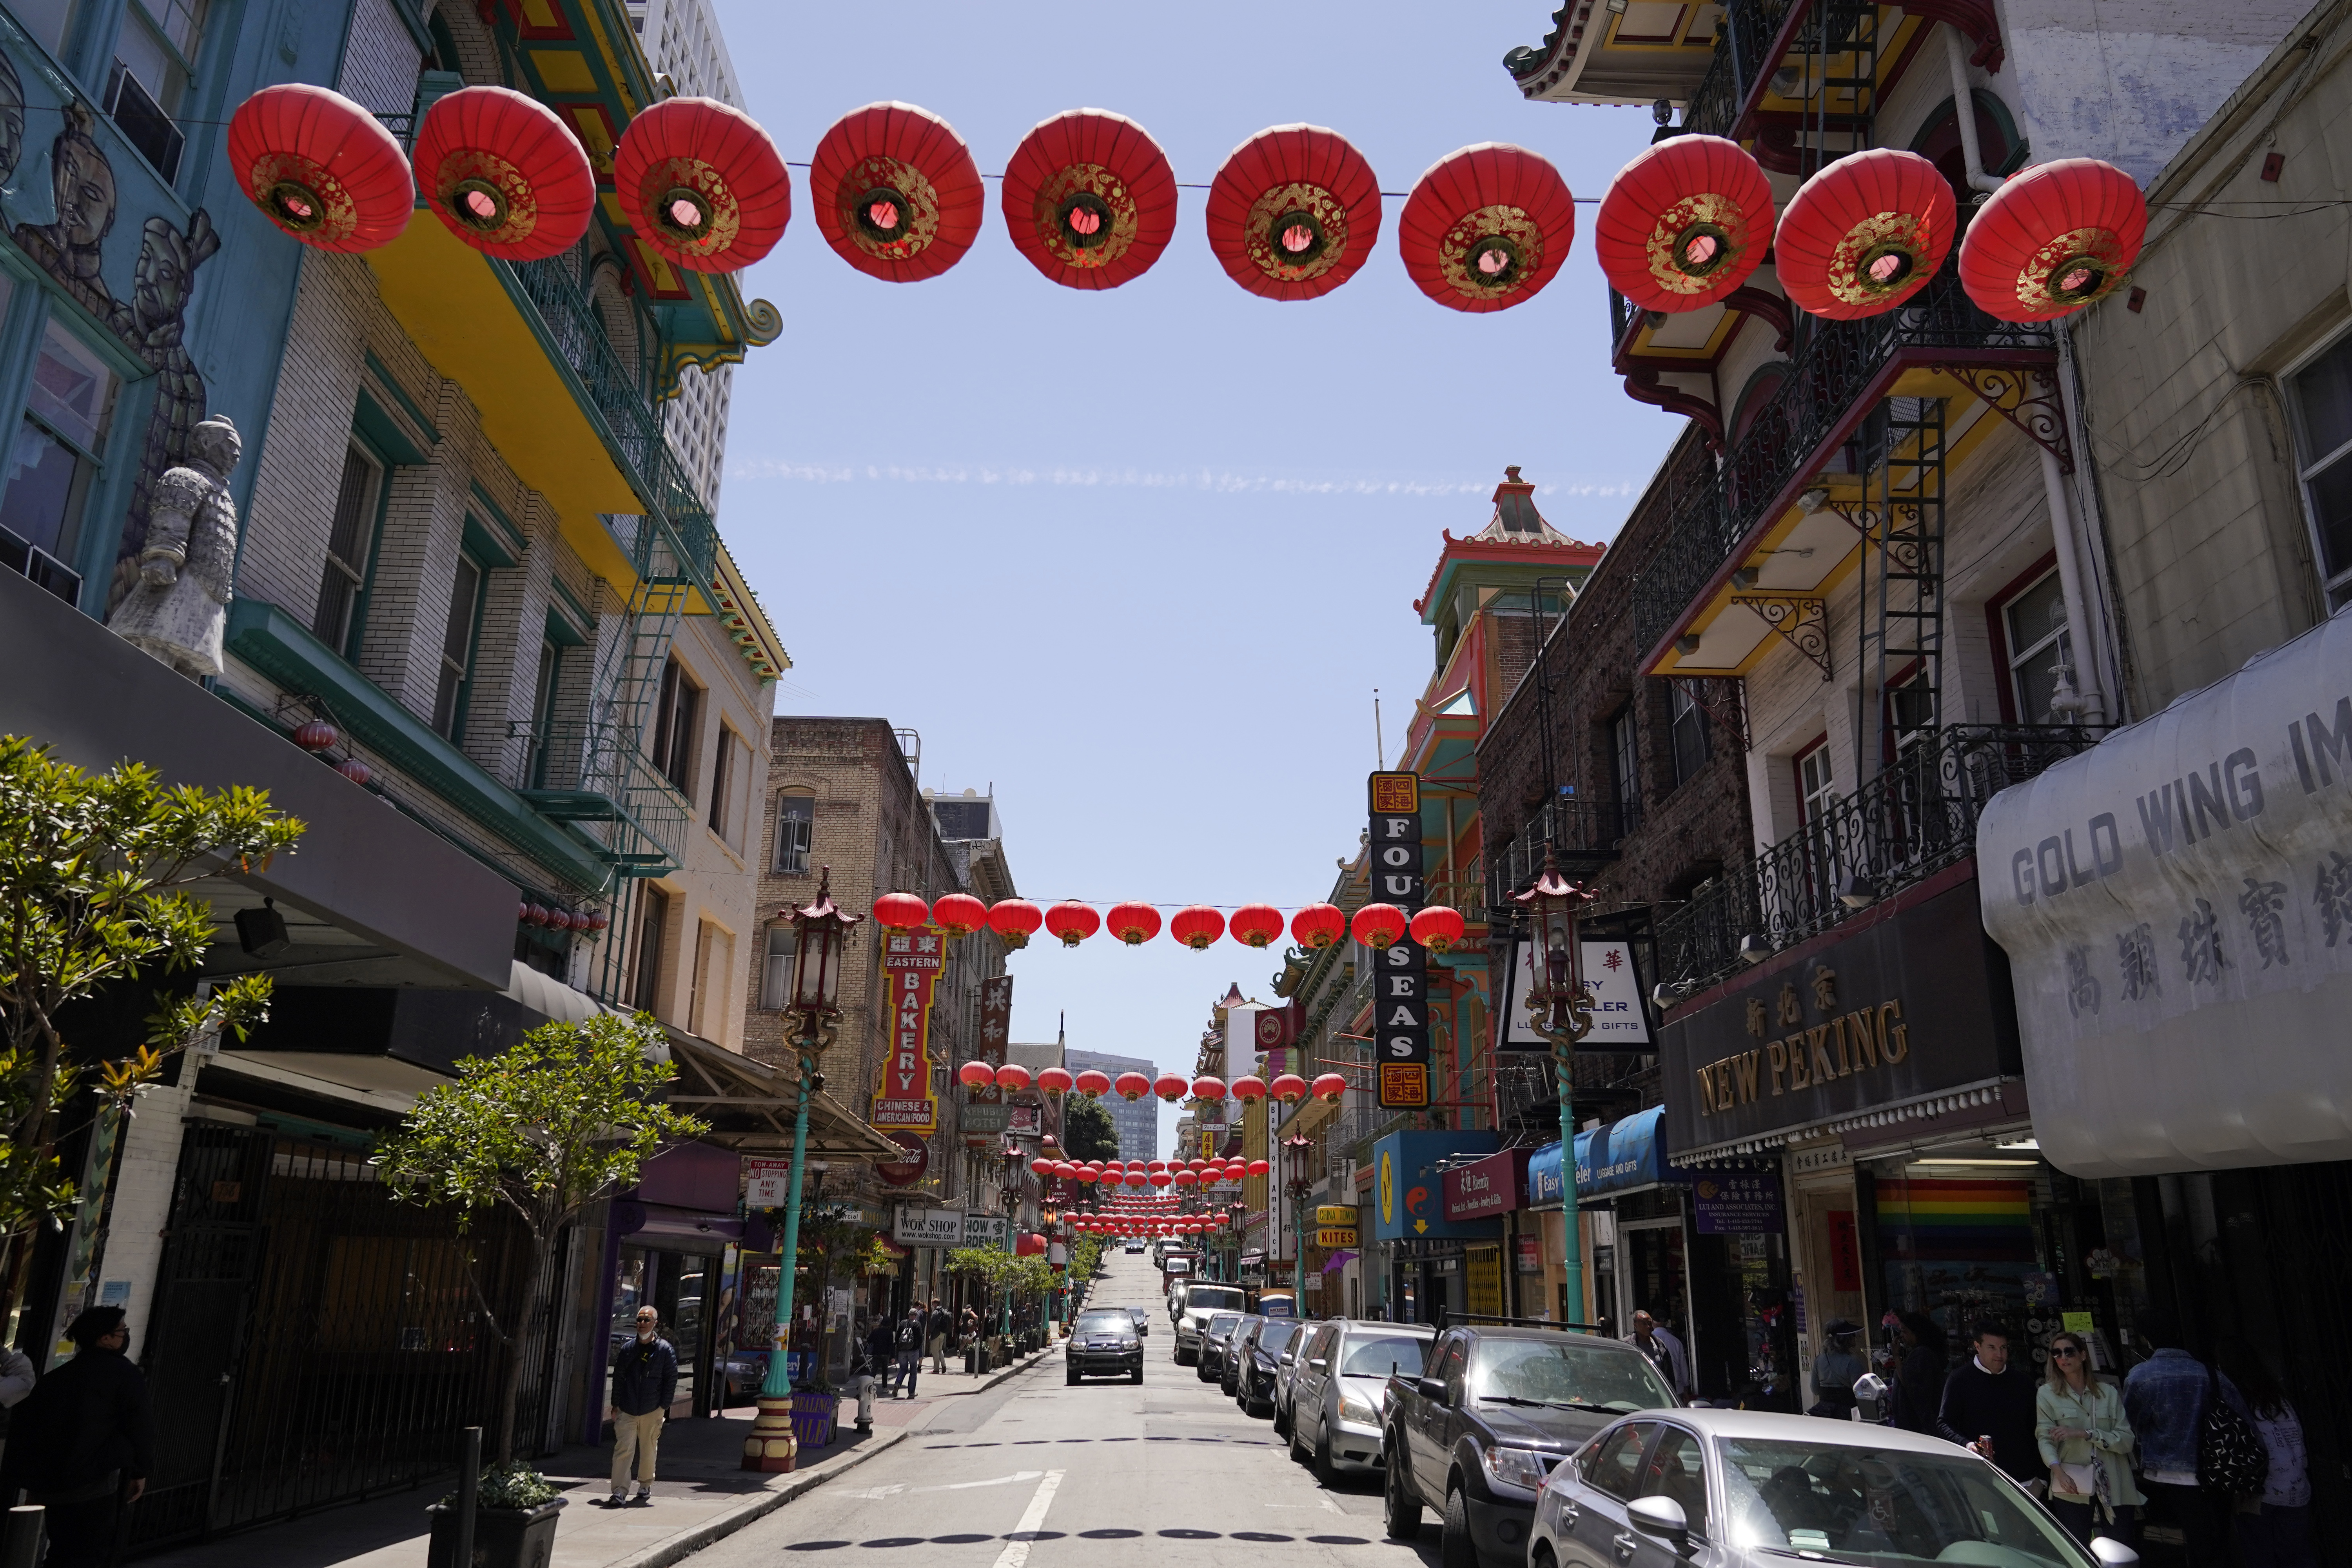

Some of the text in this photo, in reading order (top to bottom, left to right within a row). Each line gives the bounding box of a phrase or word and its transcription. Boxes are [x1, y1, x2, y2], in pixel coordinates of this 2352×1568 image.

[2012, 812, 2123, 907] GOLD
[2136, 747, 2265, 859] WING
[886, 957, 939, 967] EASTERN
[1388, 946, 1418, 1057] SEAS
[898, 972, 920, 1091] BAKERY
[1697, 998, 1908, 1116] NEW PEKING
[877, 1101, 930, 1112] CHINESE &
[876, 1112, 930, 1123] AMERICAN FOOD
[965, 1118, 1004, 1128] HOTEL
[1272, 1155, 1276, 1173] of
[750, 1168, 787, 1178] NO STOPPING
[1544, 1176, 1559, 1194] Easy
[1597, 1166, 1614, 1180] LUGGAGE
[1615, 1163, 1624, 1176] AND
[1625, 1160, 1637, 1172] GIFTS
[760, 1180, 775, 1188] ANY
[1472, 1172, 1489, 1191] Eternity
[759, 1189, 775, 1197] TIME
[1319, 1209, 1355, 1221] CHINA TOWN
[901, 1218, 956, 1233] WOK SHOP
[966, 1220, 989, 1233] NOW
[901, 1231, 955, 1241] www.wokshop.com
[1321, 1232, 1354, 1243] KITES
[792, 1396, 831, 1414] HEALING
